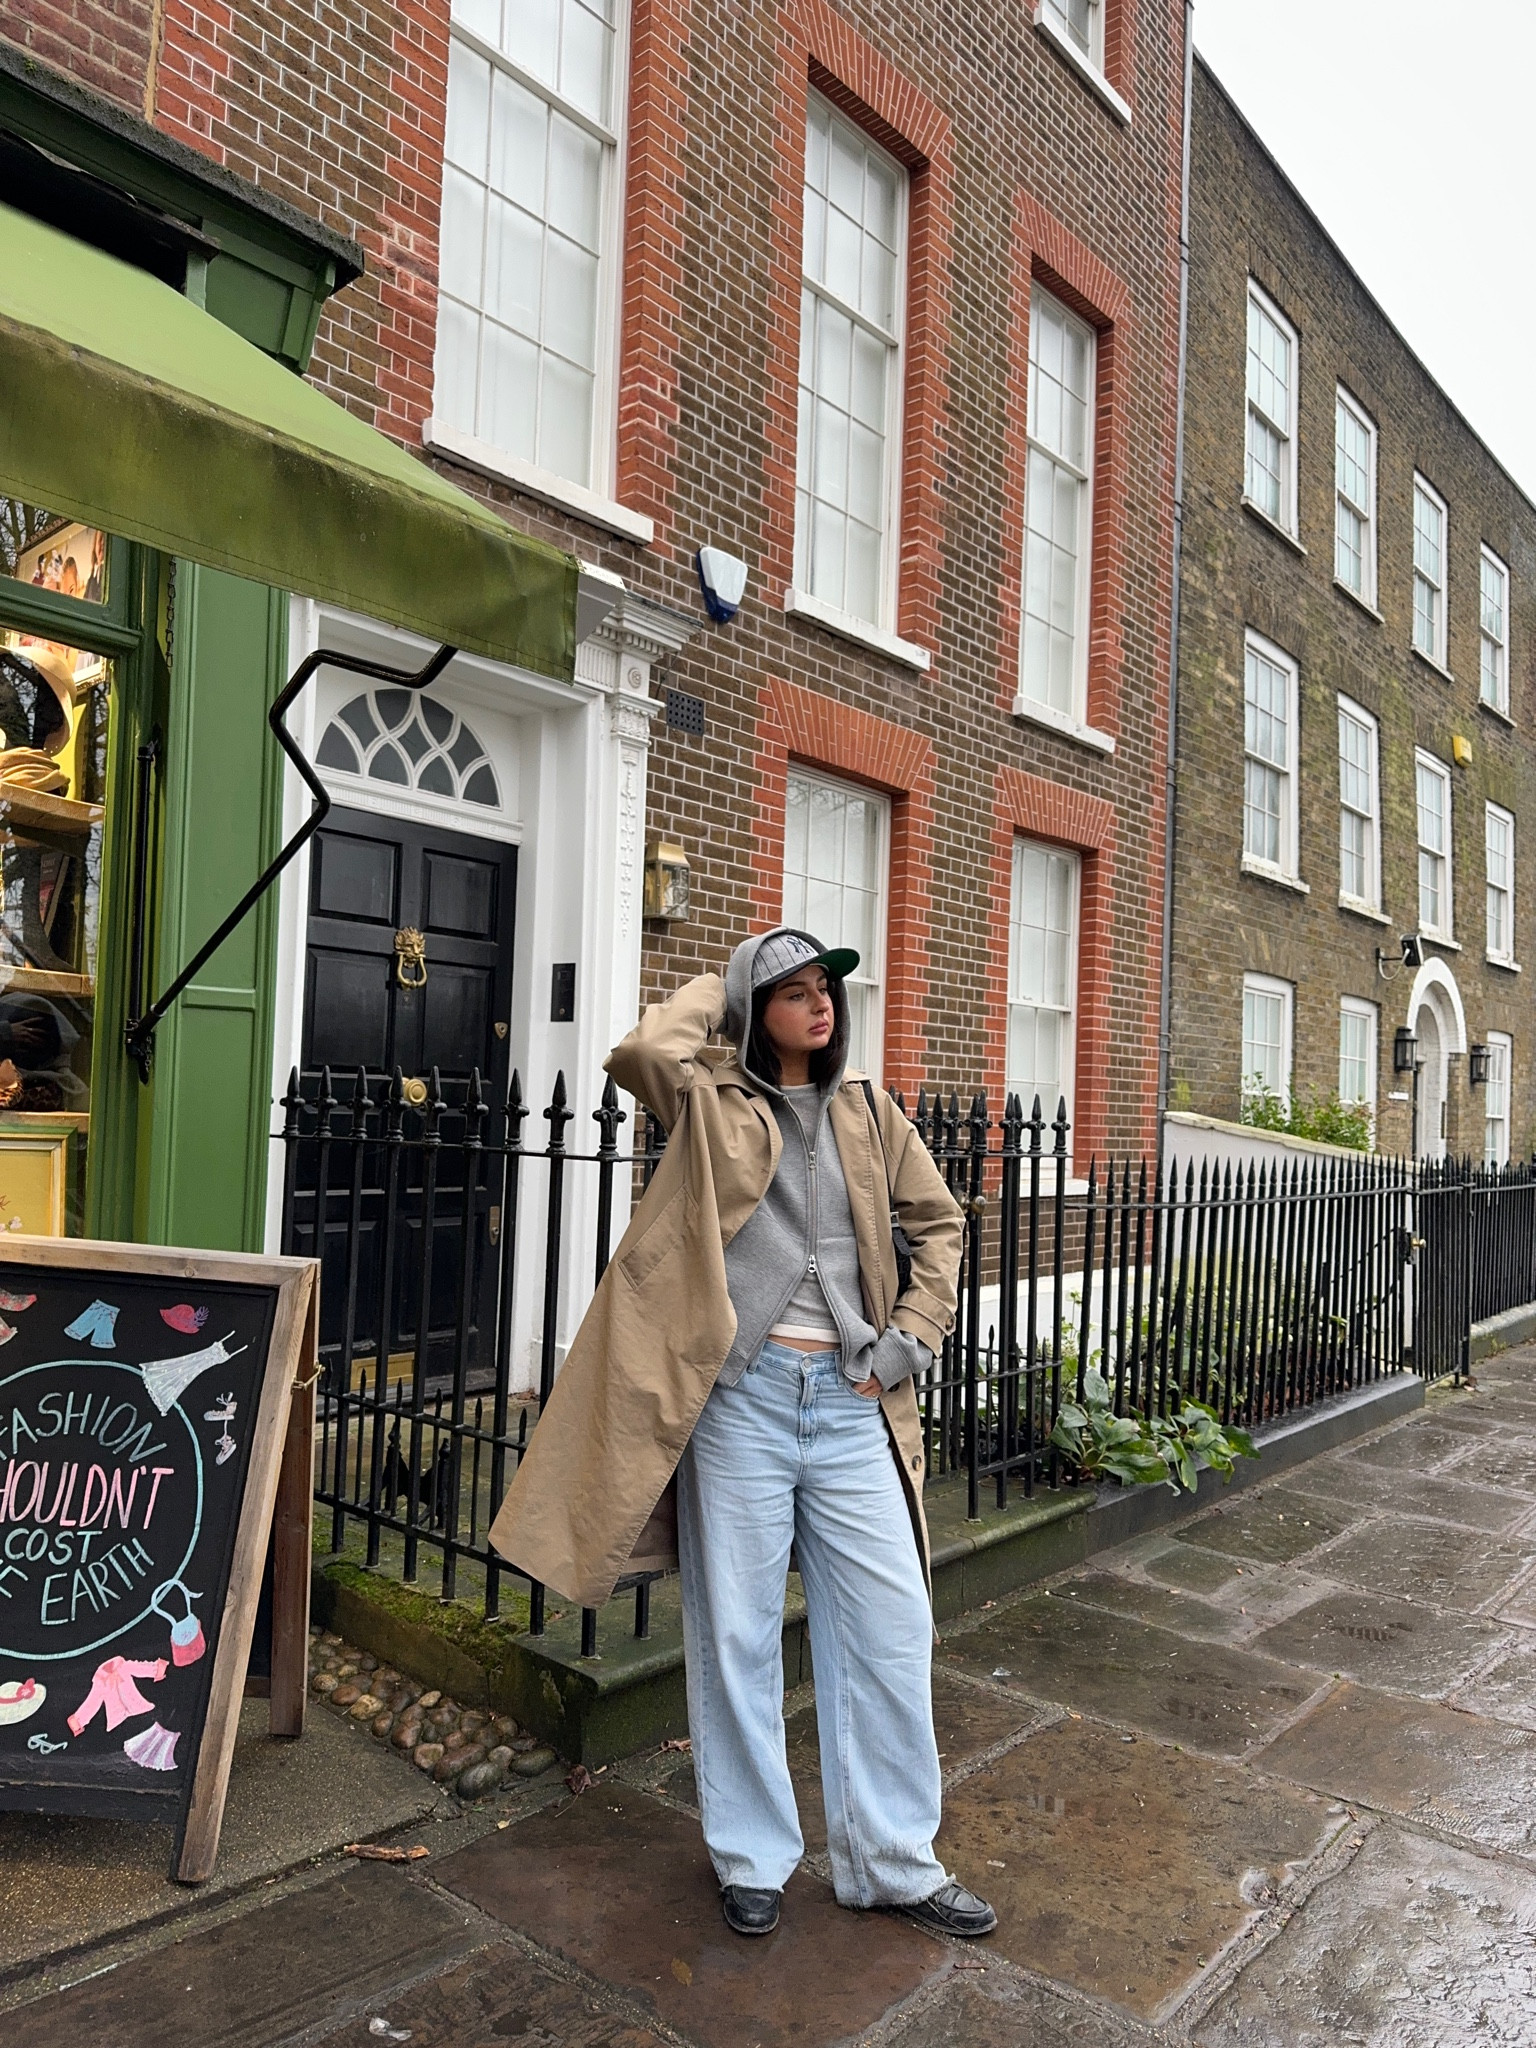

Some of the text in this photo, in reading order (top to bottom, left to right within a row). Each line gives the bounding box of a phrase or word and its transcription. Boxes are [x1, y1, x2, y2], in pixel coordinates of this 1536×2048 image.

[0, 1458, 175, 1530] HOULDN'T
[4, 1527, 103, 1566] COST
[40, 1537, 155, 1626] EARTH
